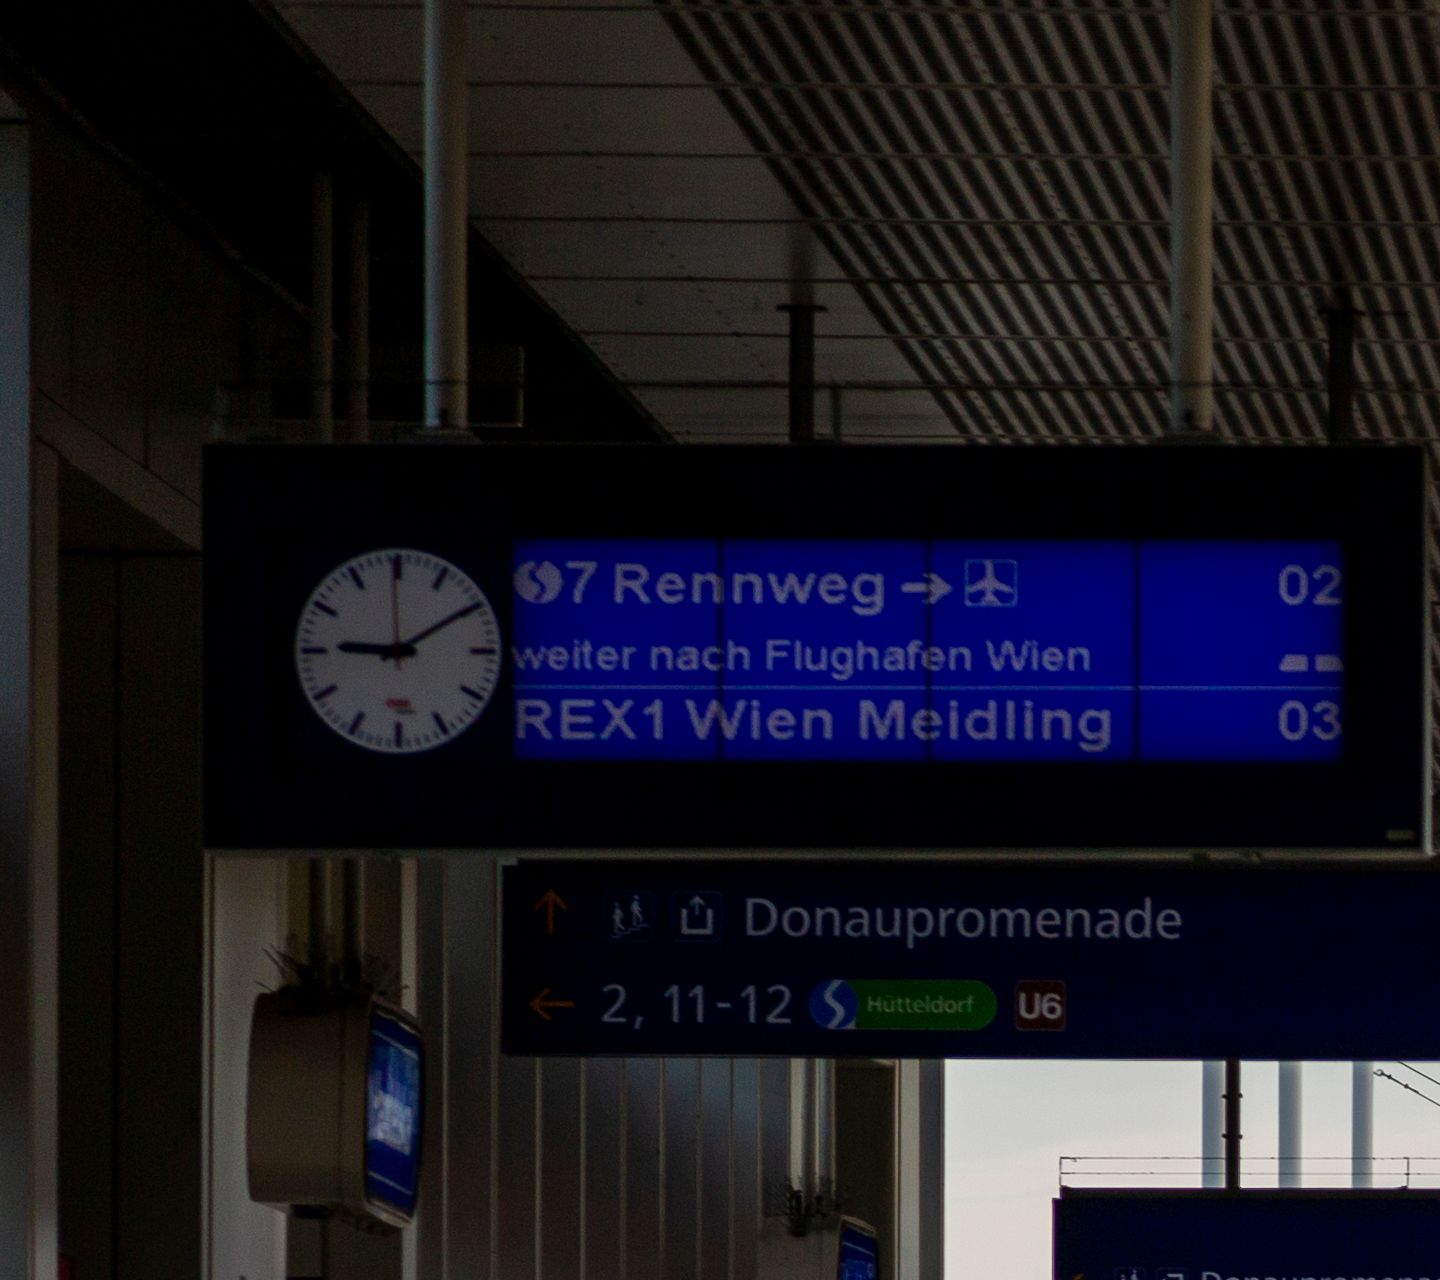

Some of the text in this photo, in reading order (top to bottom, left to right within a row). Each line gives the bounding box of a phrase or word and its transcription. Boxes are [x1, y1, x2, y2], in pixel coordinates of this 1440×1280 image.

[615, 564, 885, 614] Rennweg
[1278, 565, 1343, 607] 02
[514, 639, 1091, 680] weiter nach Flughafen Wien
[518, 699, 1111, 752] REX1 Wien Meidling
[1278, 700, 1343, 742] 03
[744, 896, 1183, 949] Donaupromenade
[664, 984, 792, 1026] 11-12
[867, 991, 975, 1015] Hütteldorf
[1019, 993, 1063, 1020] U6
